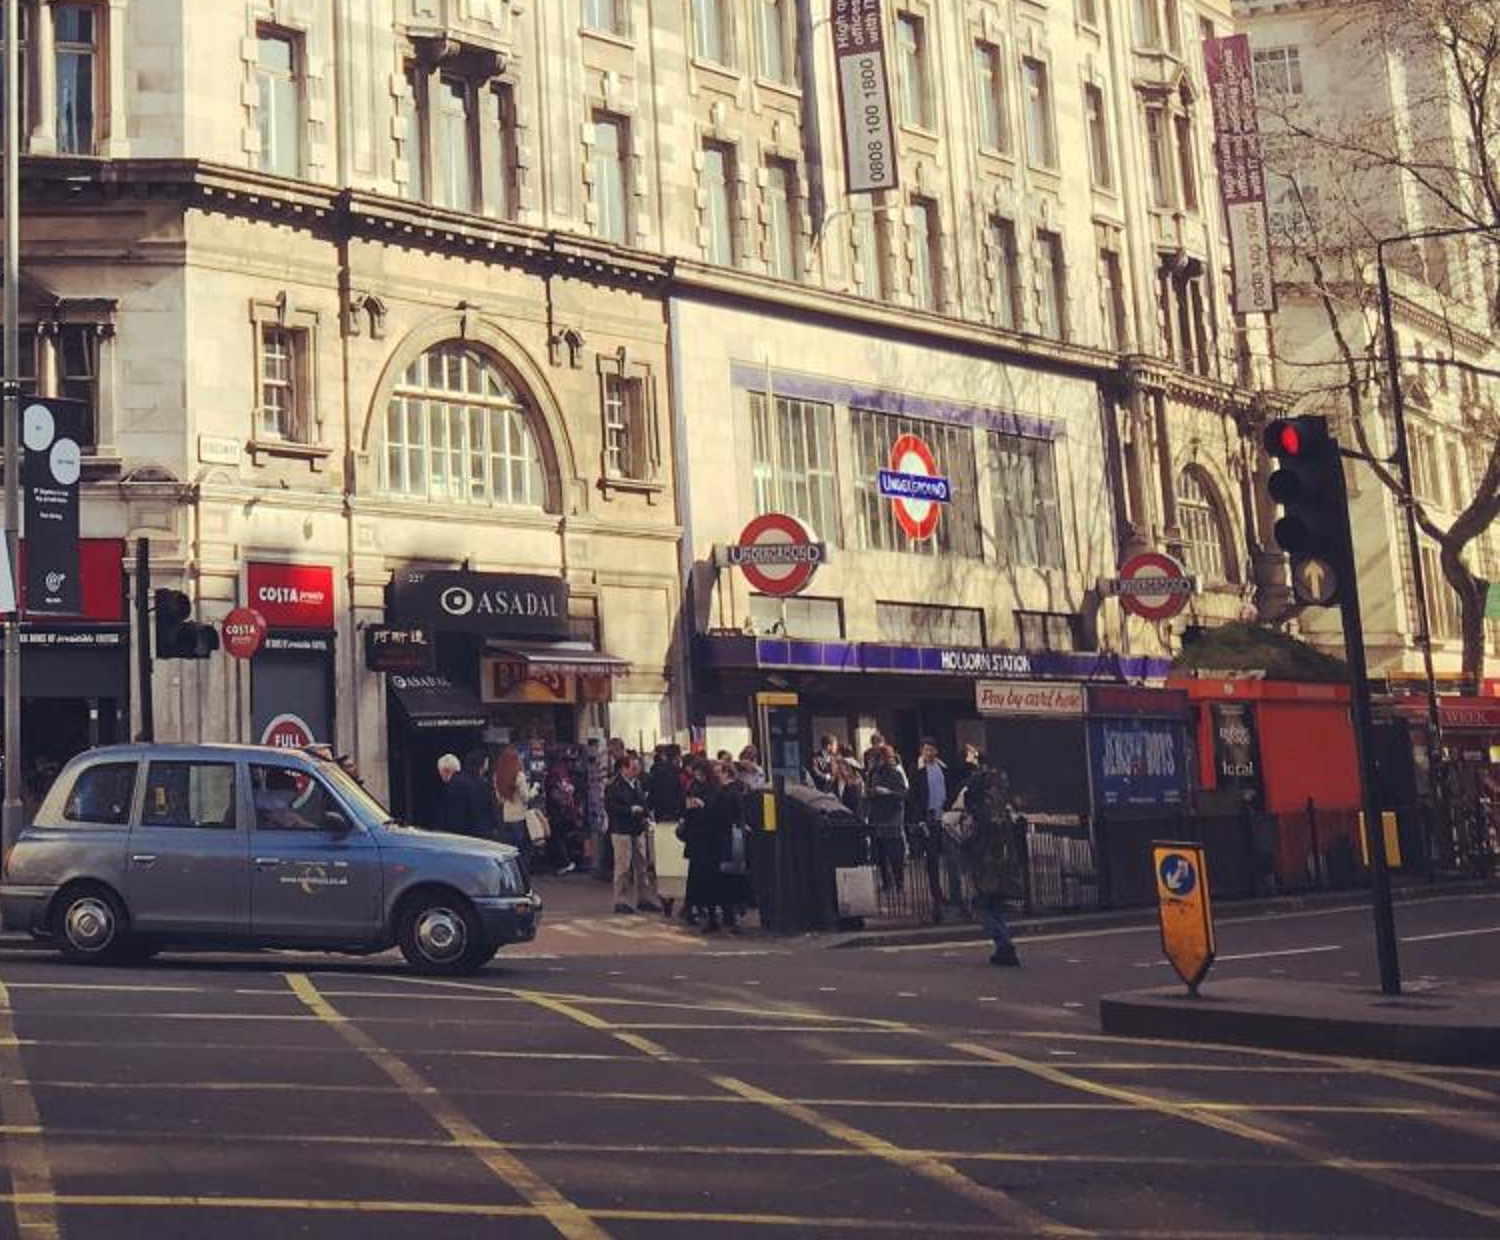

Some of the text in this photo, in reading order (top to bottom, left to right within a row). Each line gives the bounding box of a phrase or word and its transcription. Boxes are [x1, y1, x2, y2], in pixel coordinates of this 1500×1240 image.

[835, 14, 850, 48] High
[865, 12, 879, 43] with
[860, 59, 885, 182] 0808 100 1800
[258, 586, 299, 603] COSTA
[476, 590, 560, 617] ASADAL
[225, 624, 256, 635] COSTA
[941, 651, 1032, 673] HOLBORN STATION
[981, 688, 1005, 707] Pay
[1008, 687, 1024, 708] by
[275, 733, 301, 747] FULL
